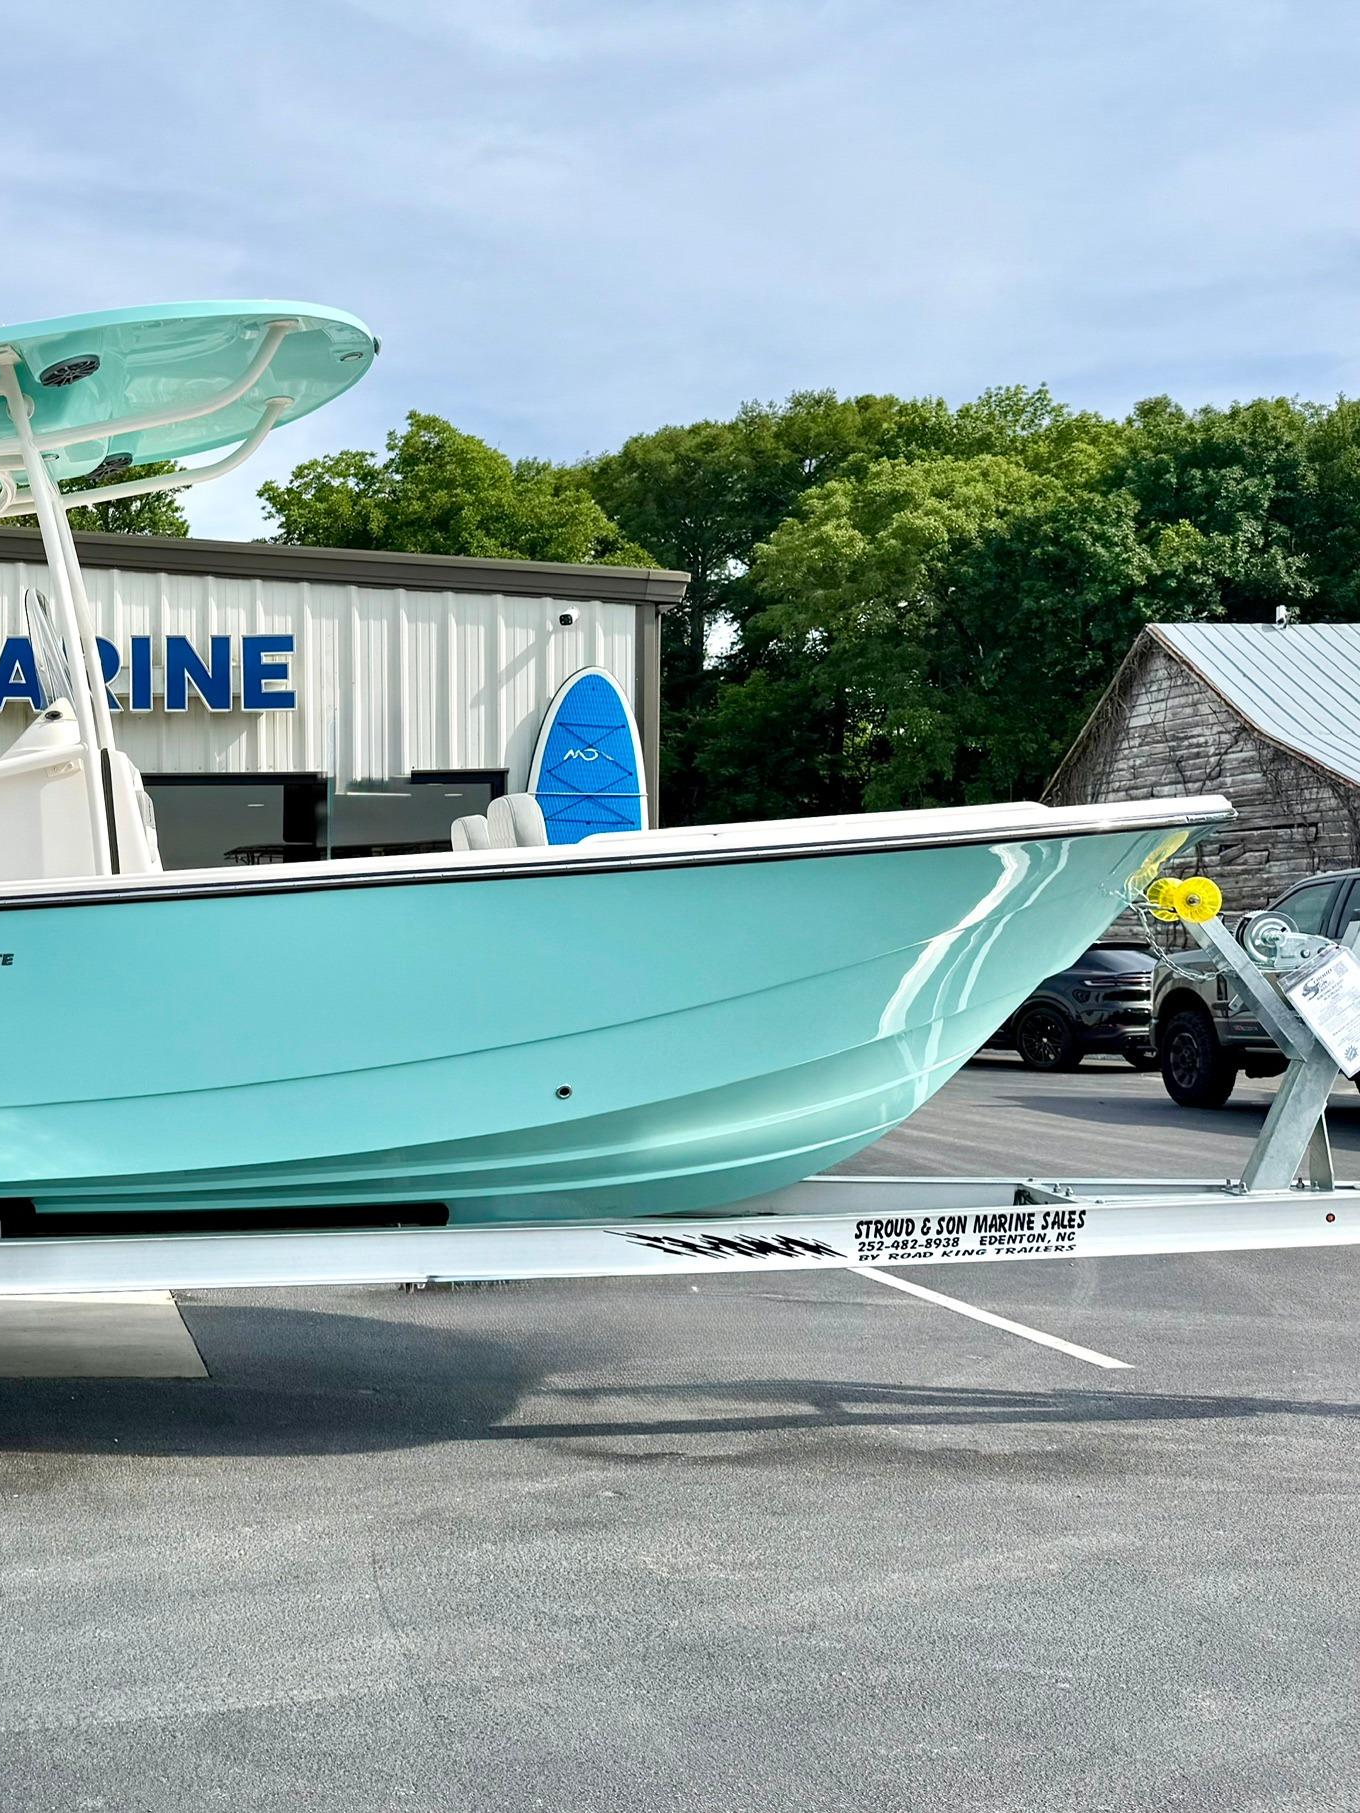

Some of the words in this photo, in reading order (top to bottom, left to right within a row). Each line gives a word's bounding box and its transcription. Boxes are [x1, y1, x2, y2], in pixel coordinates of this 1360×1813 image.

[855, 1217, 915, 1239] STROUD
[921, 1217, 931, 1236] &
[936, 1215, 968, 1236] SON
[973, 1212, 1036, 1234] MARINE
[1041, 1210, 1087, 1230] SALES
[858, 1237, 960, 1252] 252-482-8938
[979, 1233, 1051, 1246] EDENTON,
[1056, 1231, 1076, 1242] NC
[858, 1252, 879, 1261] BY
[888, 1251, 934, 1260] ROAD
[941, 1248, 987, 1257] KING
[995, 1244, 1077, 1255] TRAILERS
